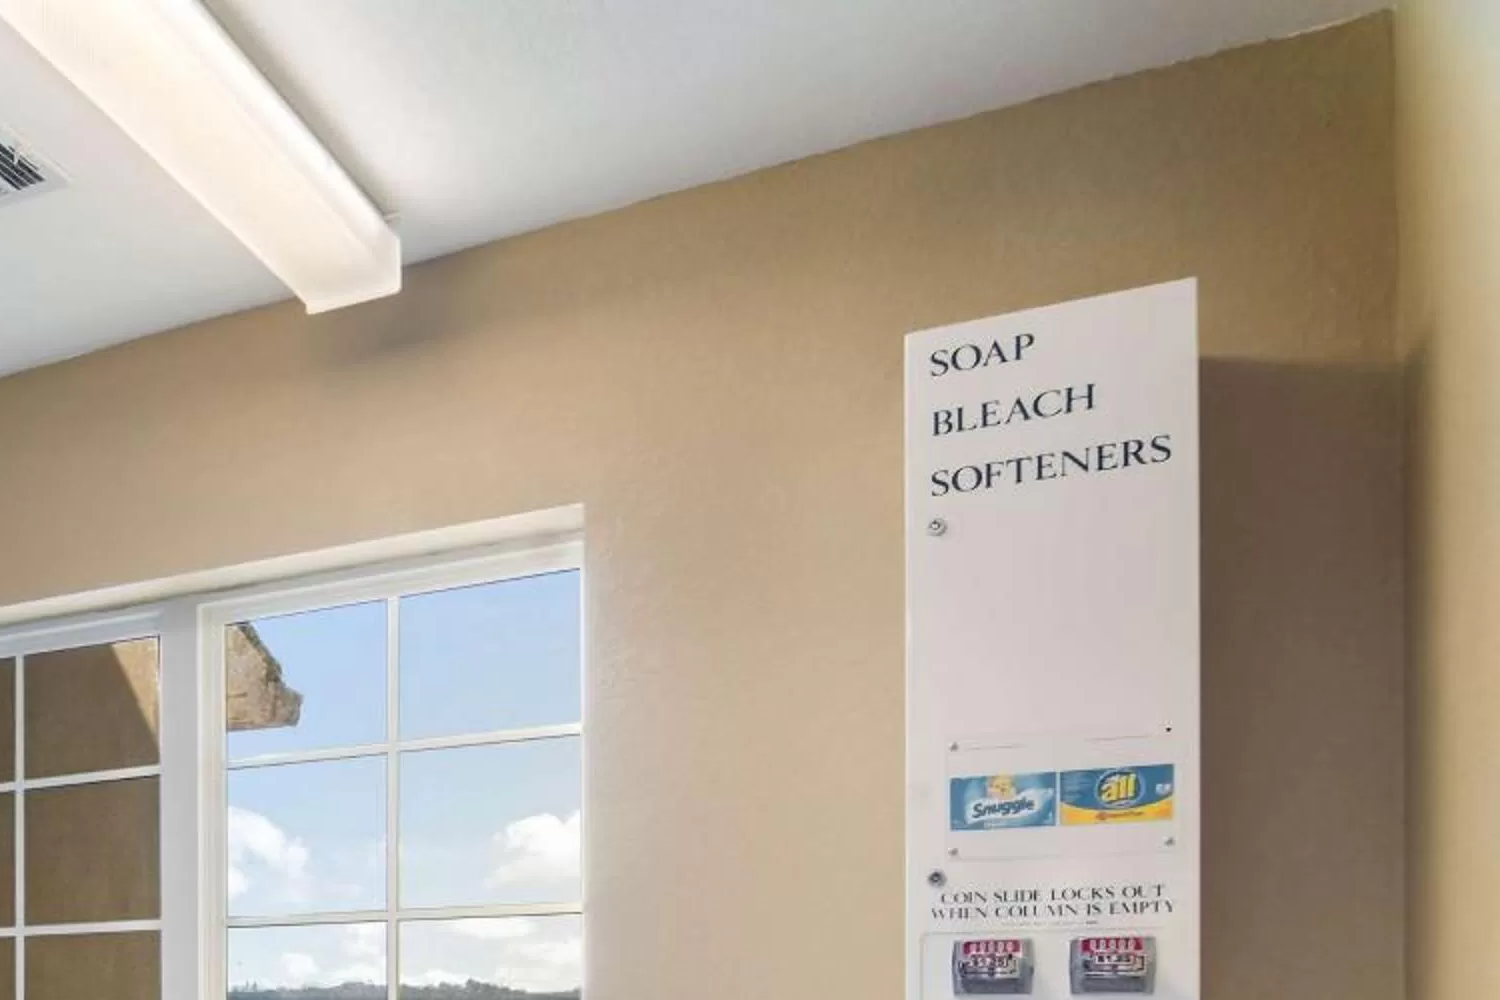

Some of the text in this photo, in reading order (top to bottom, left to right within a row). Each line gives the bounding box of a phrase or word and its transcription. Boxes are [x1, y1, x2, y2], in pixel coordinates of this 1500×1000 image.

[929, 333, 1036, 377] SOAP
[932, 383, 1096, 436] BLEACH
[930, 434, 1172, 497] SOFTENERS
[1100, 773, 1137, 801] all
[971, 799, 1036, 819] Snuggle
[941, 883, 1166, 904] COIN SLIDE LOCKS OUT
[931, 900, 1176, 921] WHEN COLUMN IS EMPTY
